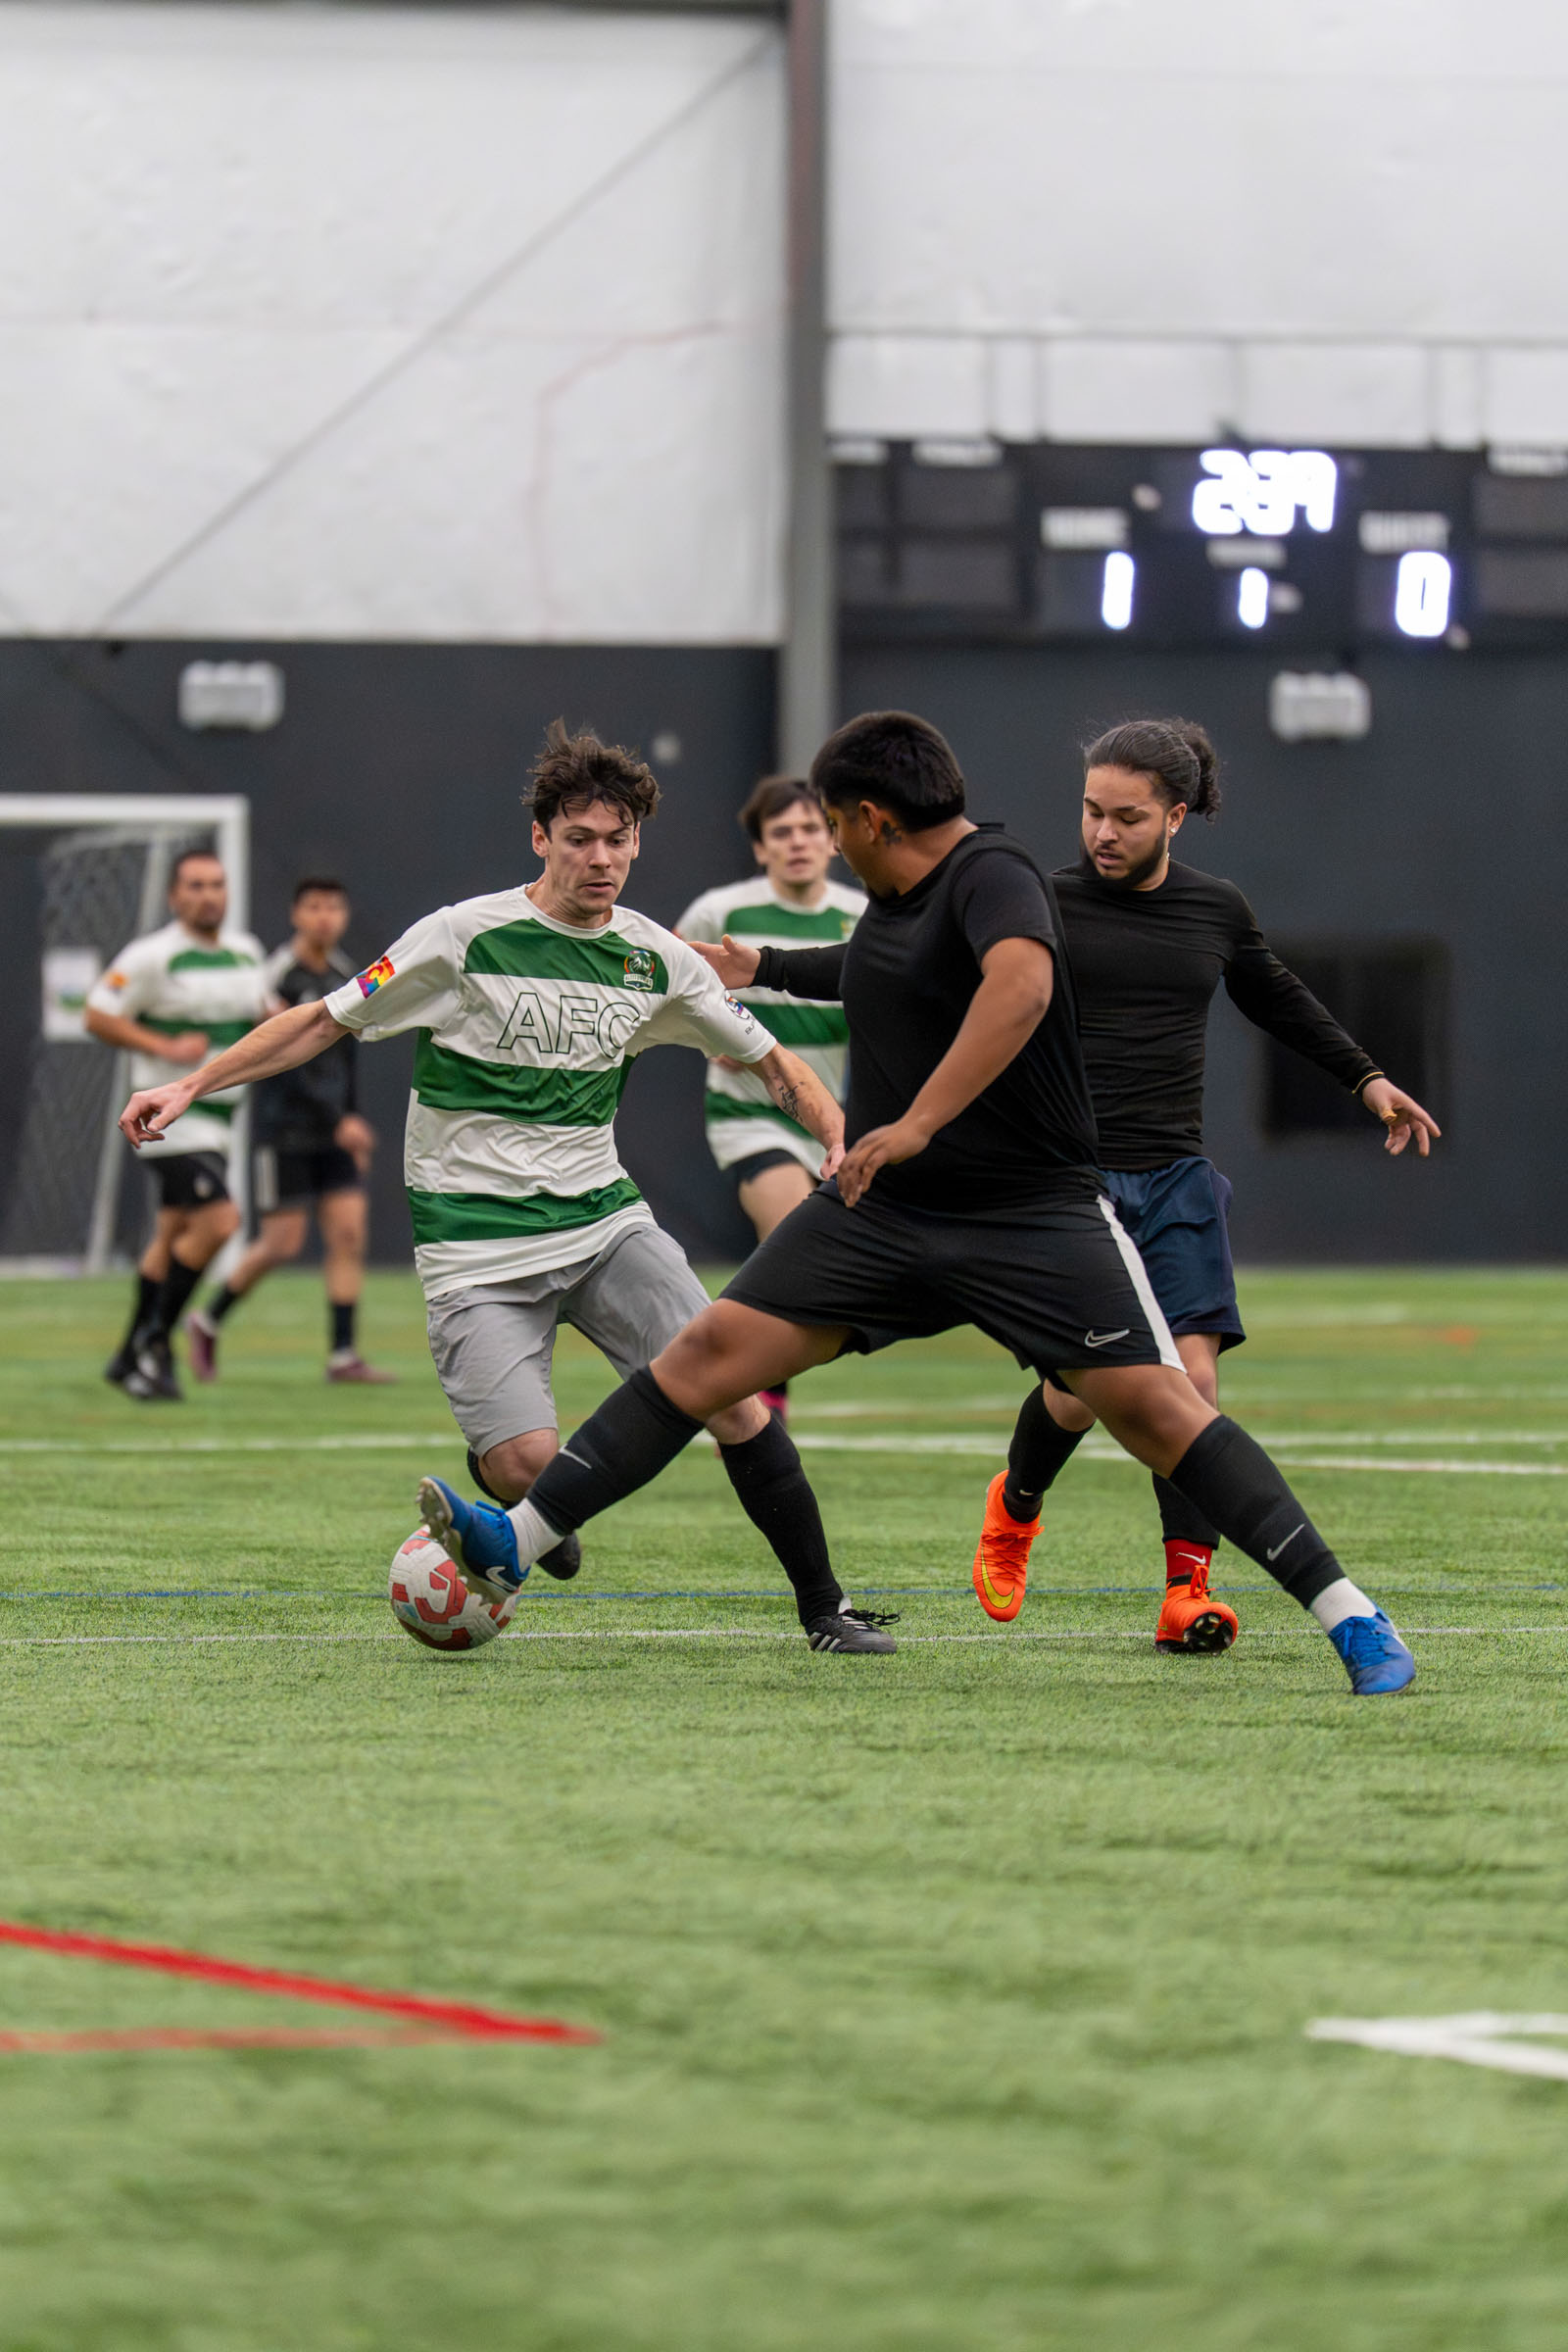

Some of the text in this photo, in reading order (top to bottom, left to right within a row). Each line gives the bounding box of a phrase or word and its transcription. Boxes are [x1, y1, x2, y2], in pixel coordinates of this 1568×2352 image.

[1102, 551, 1135, 629] 1
[1238, 567, 1268, 629] 1
[1396, 551, 1451, 637] 0
[497, 992, 640, 1058] AFC
